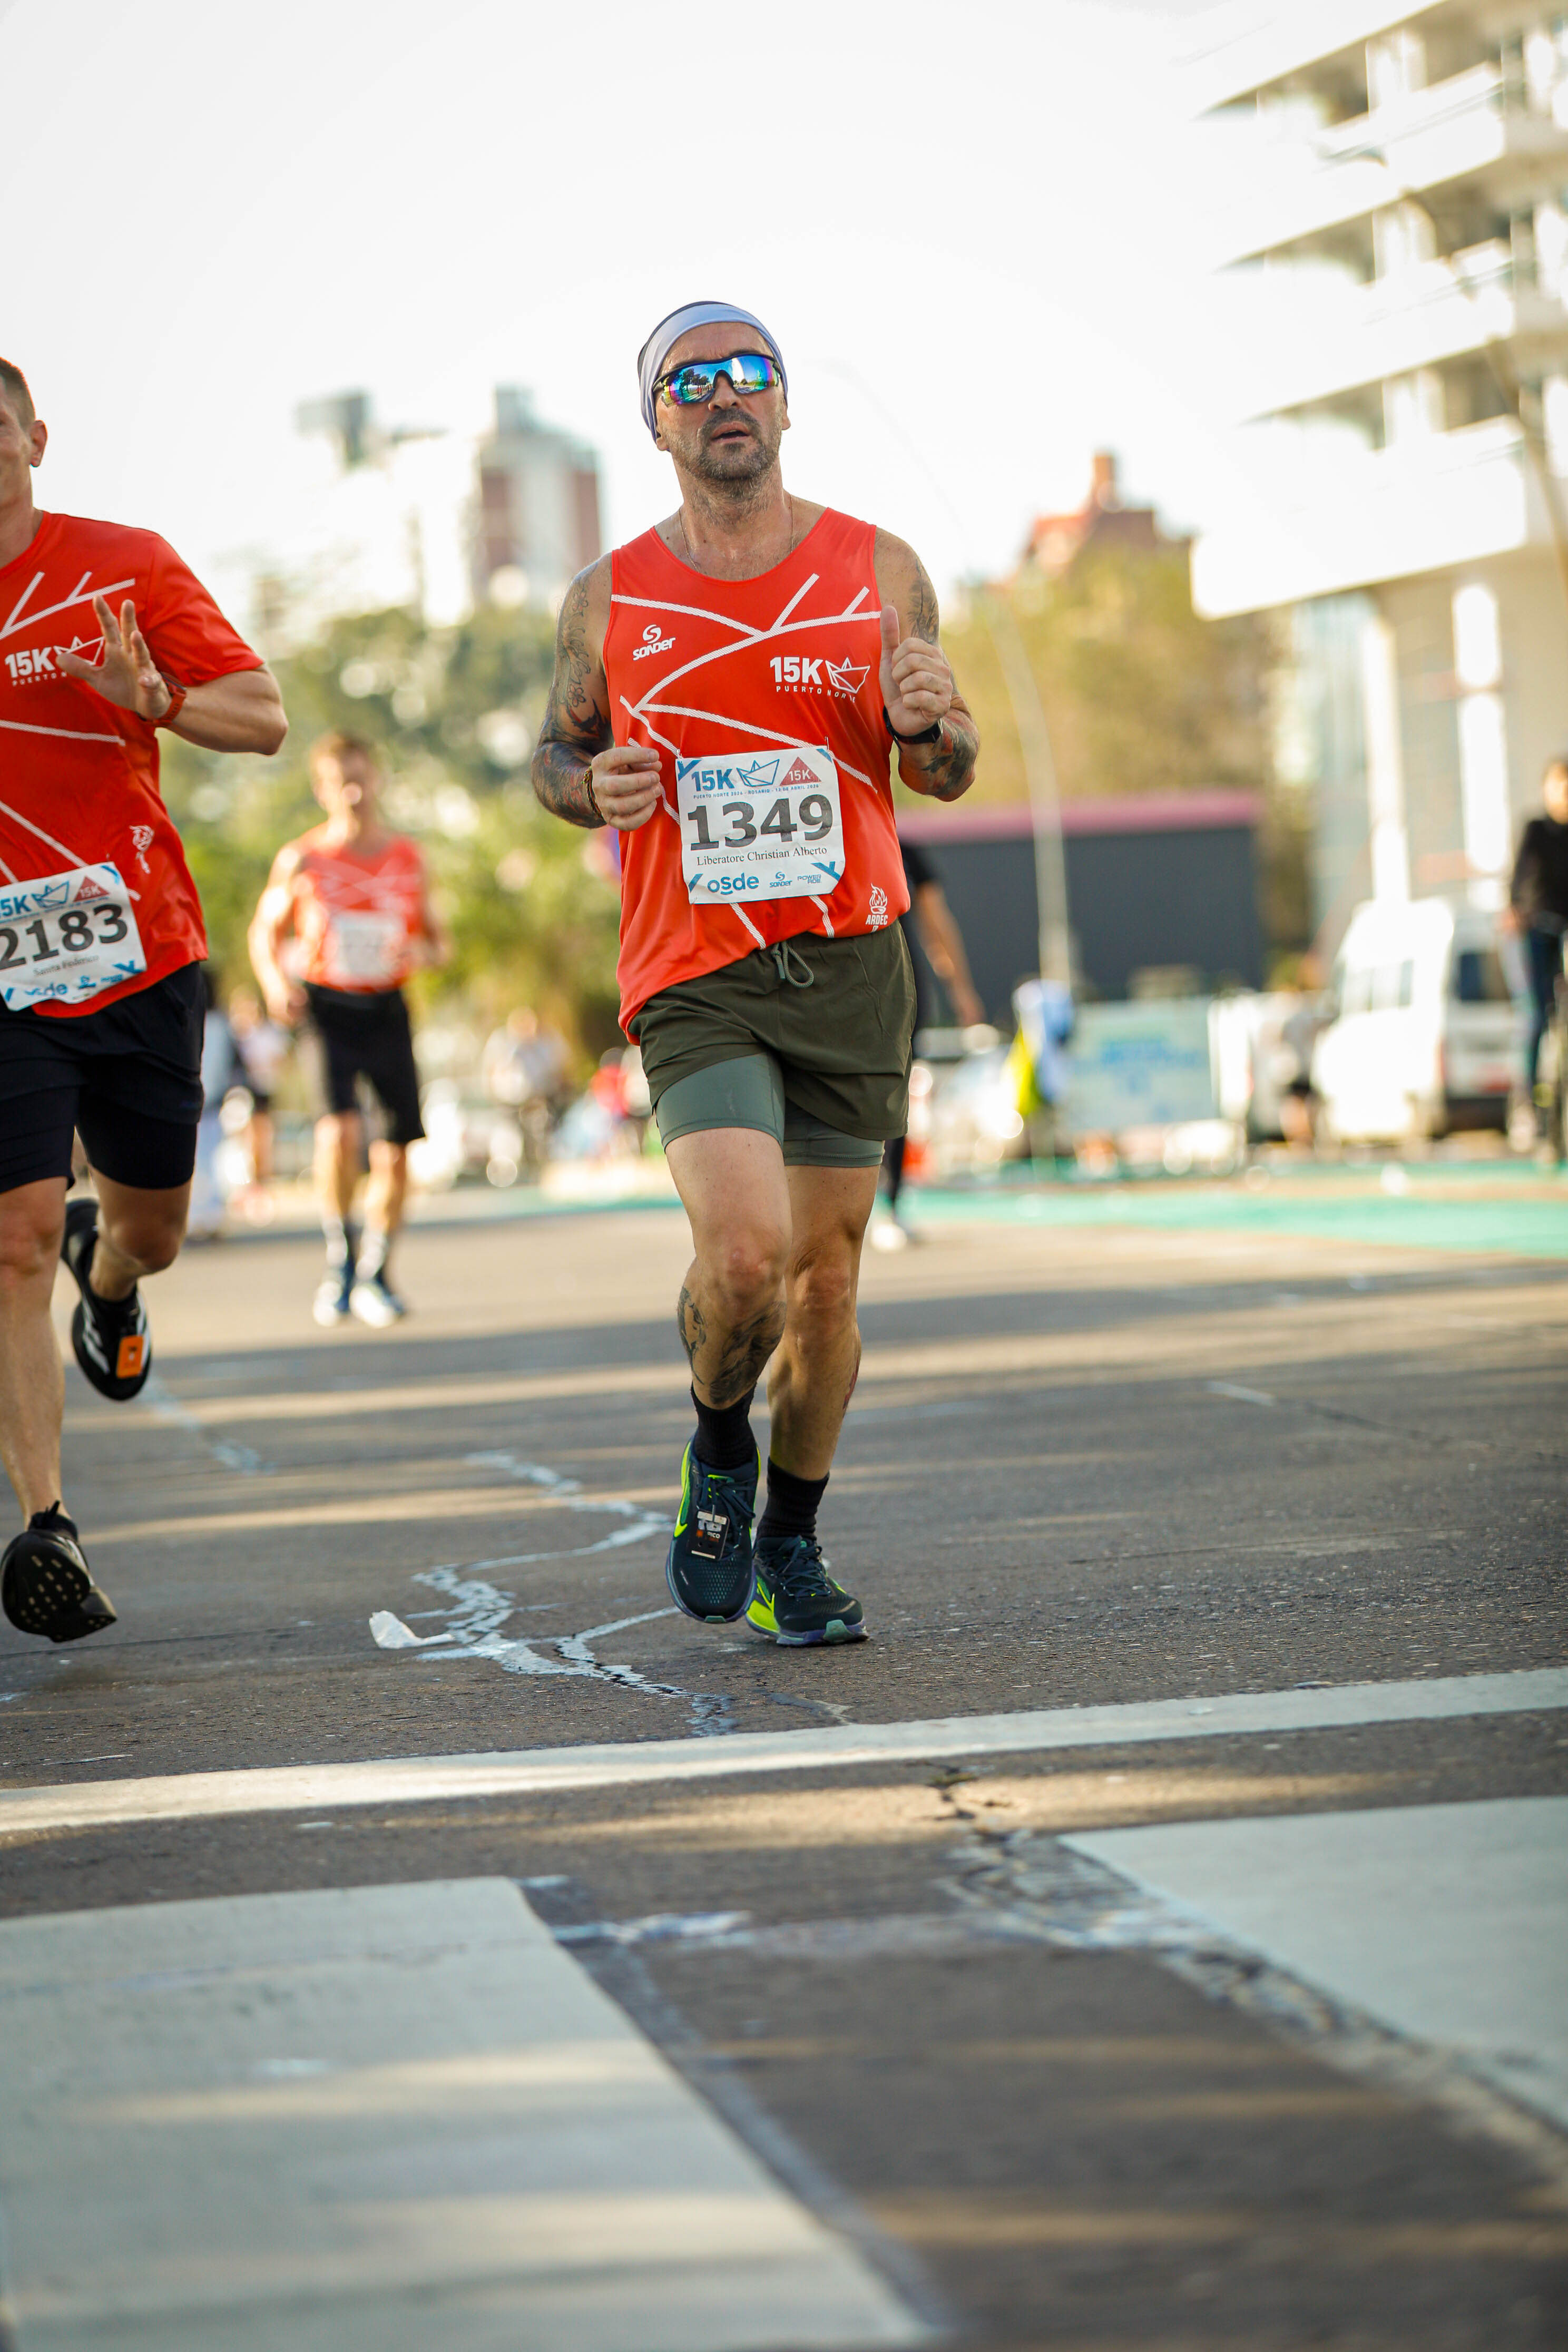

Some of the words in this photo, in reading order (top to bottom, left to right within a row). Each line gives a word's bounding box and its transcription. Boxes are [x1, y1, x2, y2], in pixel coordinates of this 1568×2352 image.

[5, 646, 55, 678] 15K
[770, 656, 824, 684] 15K
[776, 685, 822, 694] PUERTO
[691, 768, 735, 792] 15K
[789, 769, 811, 781] 15K
[688, 793, 833, 851] 1349
[697, 855, 744, 866] Liberatore
[747, 850, 790, 861] Christian
[793, 846, 827, 856] Alberto
[707, 872, 759, 895] osde
[0, 894, 32, 917] 5K
[865, 914, 888, 925] ARDEC
[0, 903, 128, 971] 2183
